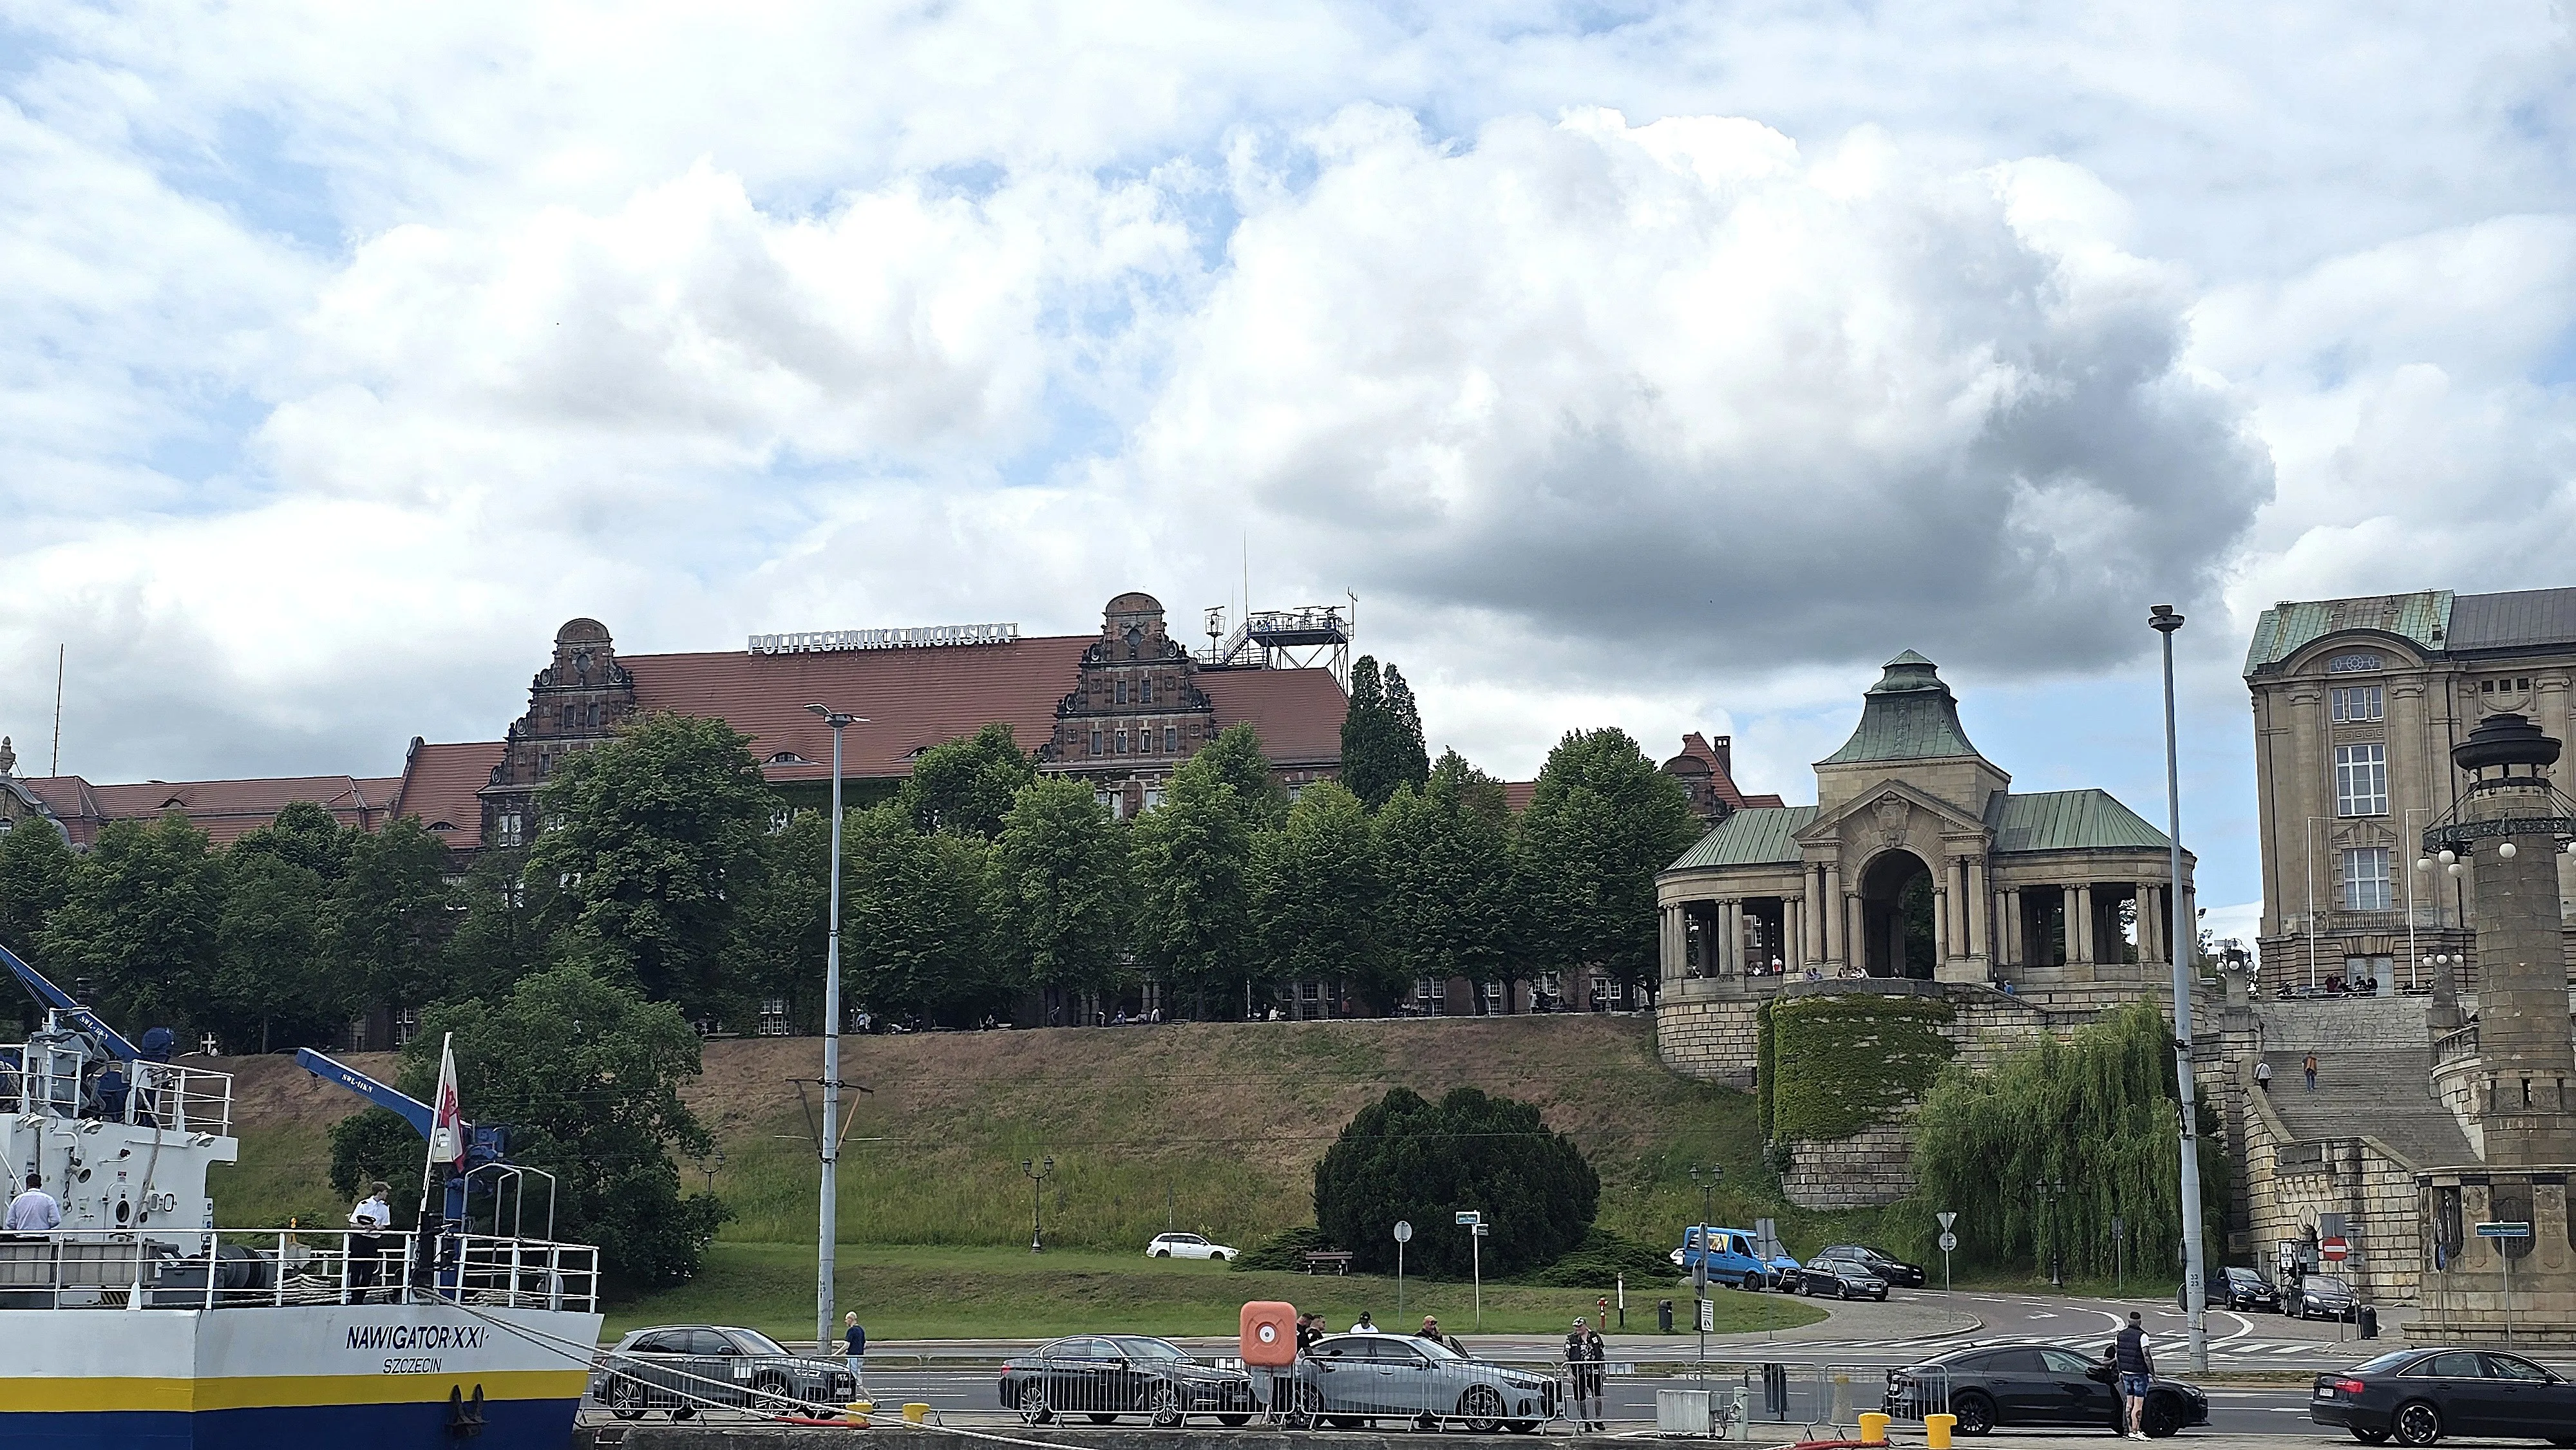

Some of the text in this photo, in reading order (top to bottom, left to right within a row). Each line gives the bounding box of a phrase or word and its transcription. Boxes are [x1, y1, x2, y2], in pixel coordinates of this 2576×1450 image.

[748, 623, 1010, 655] POLITECHNIKA MORSKA
[383, 1357, 442, 1374] SZCZECIN
